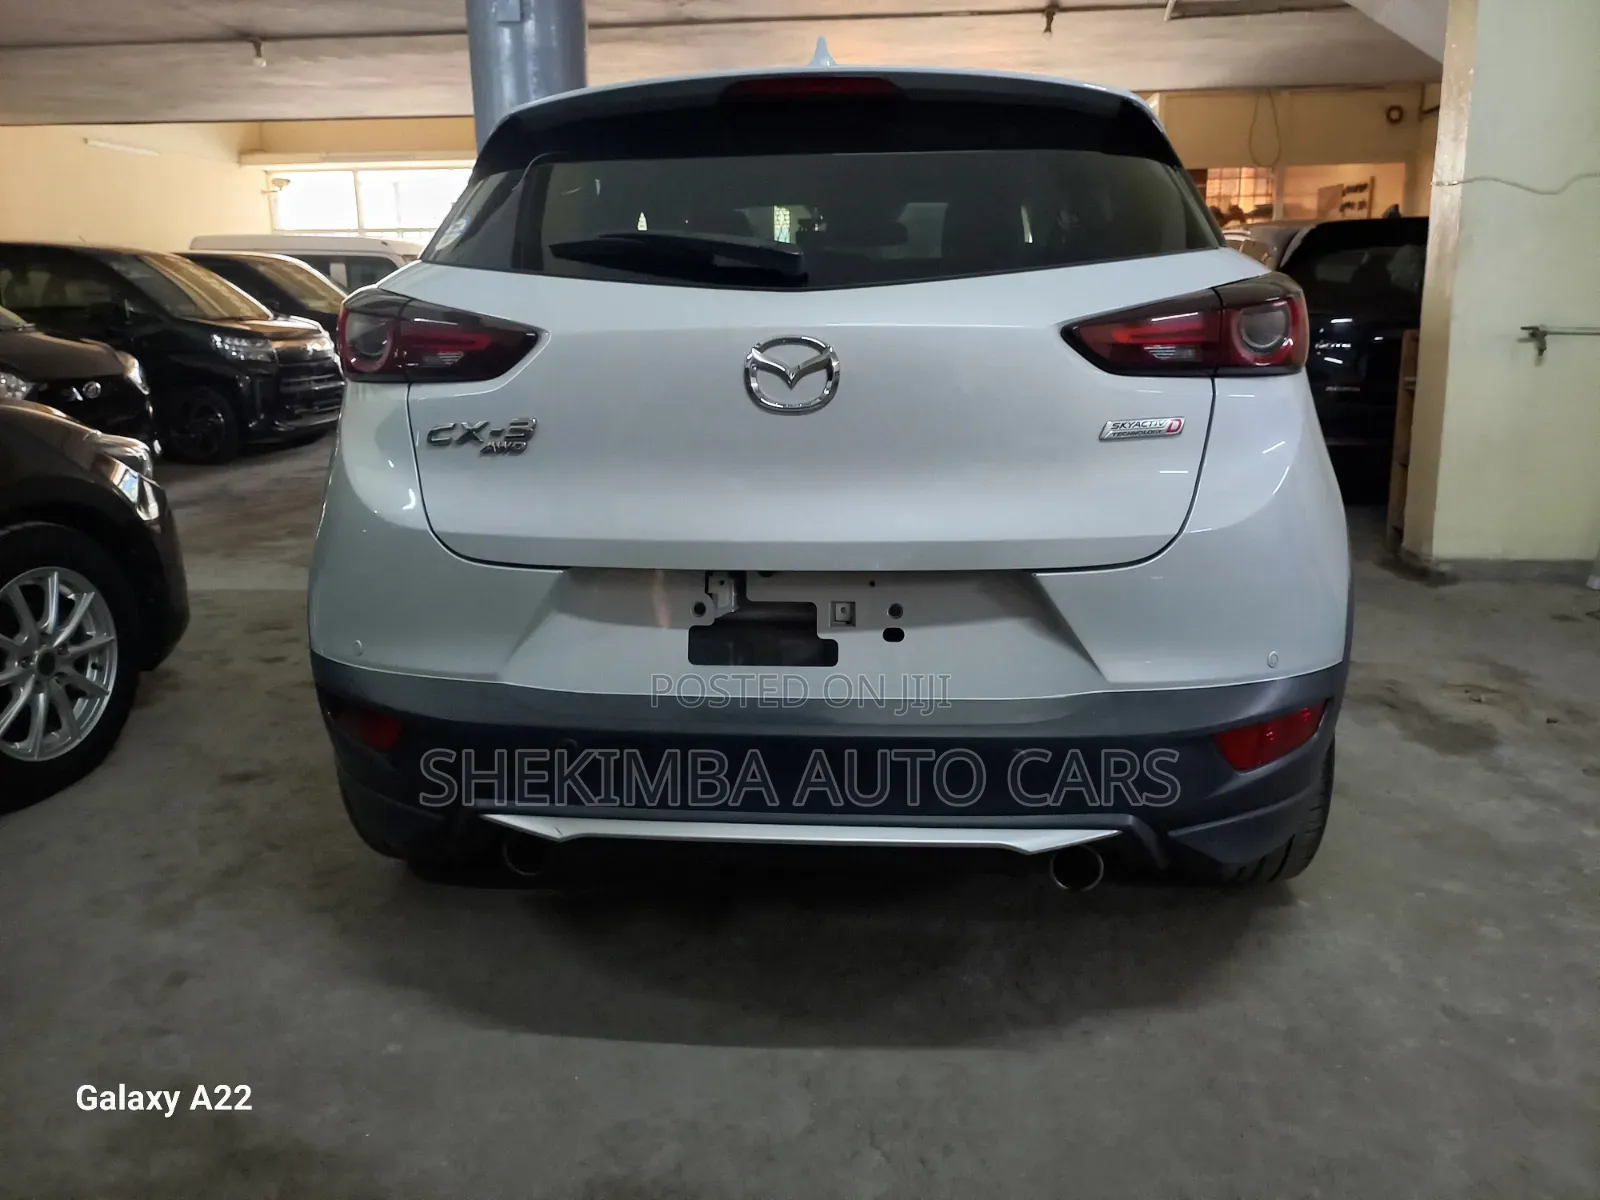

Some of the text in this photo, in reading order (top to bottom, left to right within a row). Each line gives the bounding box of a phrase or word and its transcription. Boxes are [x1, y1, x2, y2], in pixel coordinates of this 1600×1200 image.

[427, 417, 537, 446] CX-3
[1111, 420, 1166, 430] SKYACTIV
[479, 441, 528, 456] AWD
